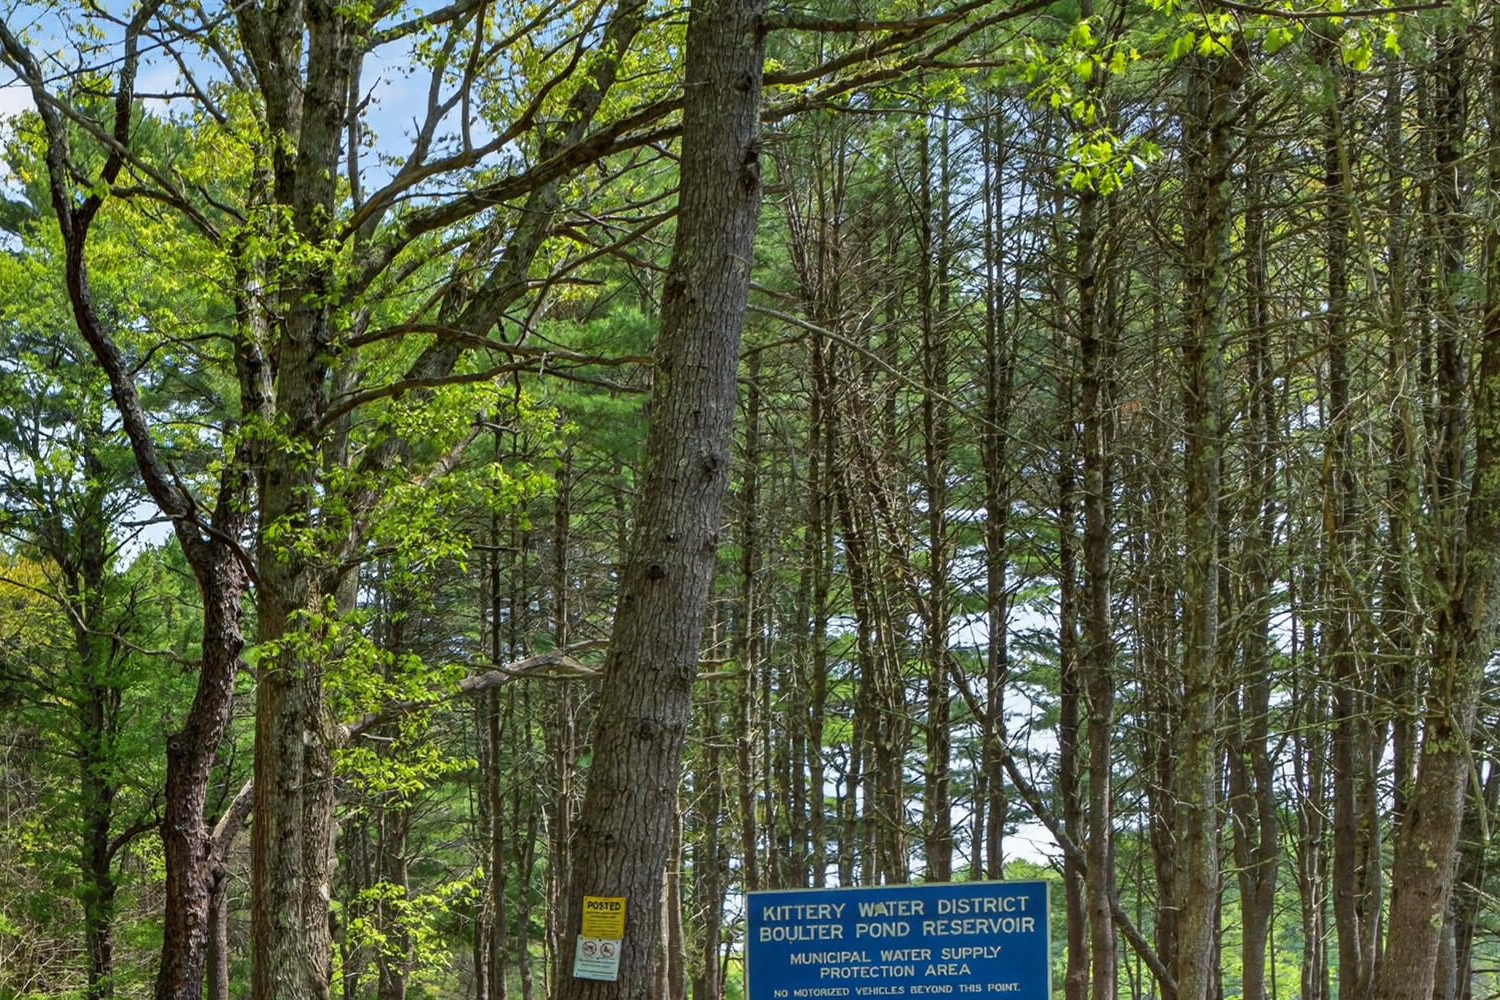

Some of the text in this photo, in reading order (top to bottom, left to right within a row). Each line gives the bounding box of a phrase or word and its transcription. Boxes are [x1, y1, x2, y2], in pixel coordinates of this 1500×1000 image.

[587, 901, 621, 911] POSTED
[763, 896, 1029, 921] KITTERY WATER DISTRICT
[760, 917, 1035, 942] BOULTER POND RESERVOIR
[790, 946, 1002, 965] MUNICIPAL WATER SUPPLY
[820, 963, 971, 979] PROTECTION AREA
[774, 982, 1020, 998] NO MOTORIZED VEHICLES BEYOND THIS POINT.
